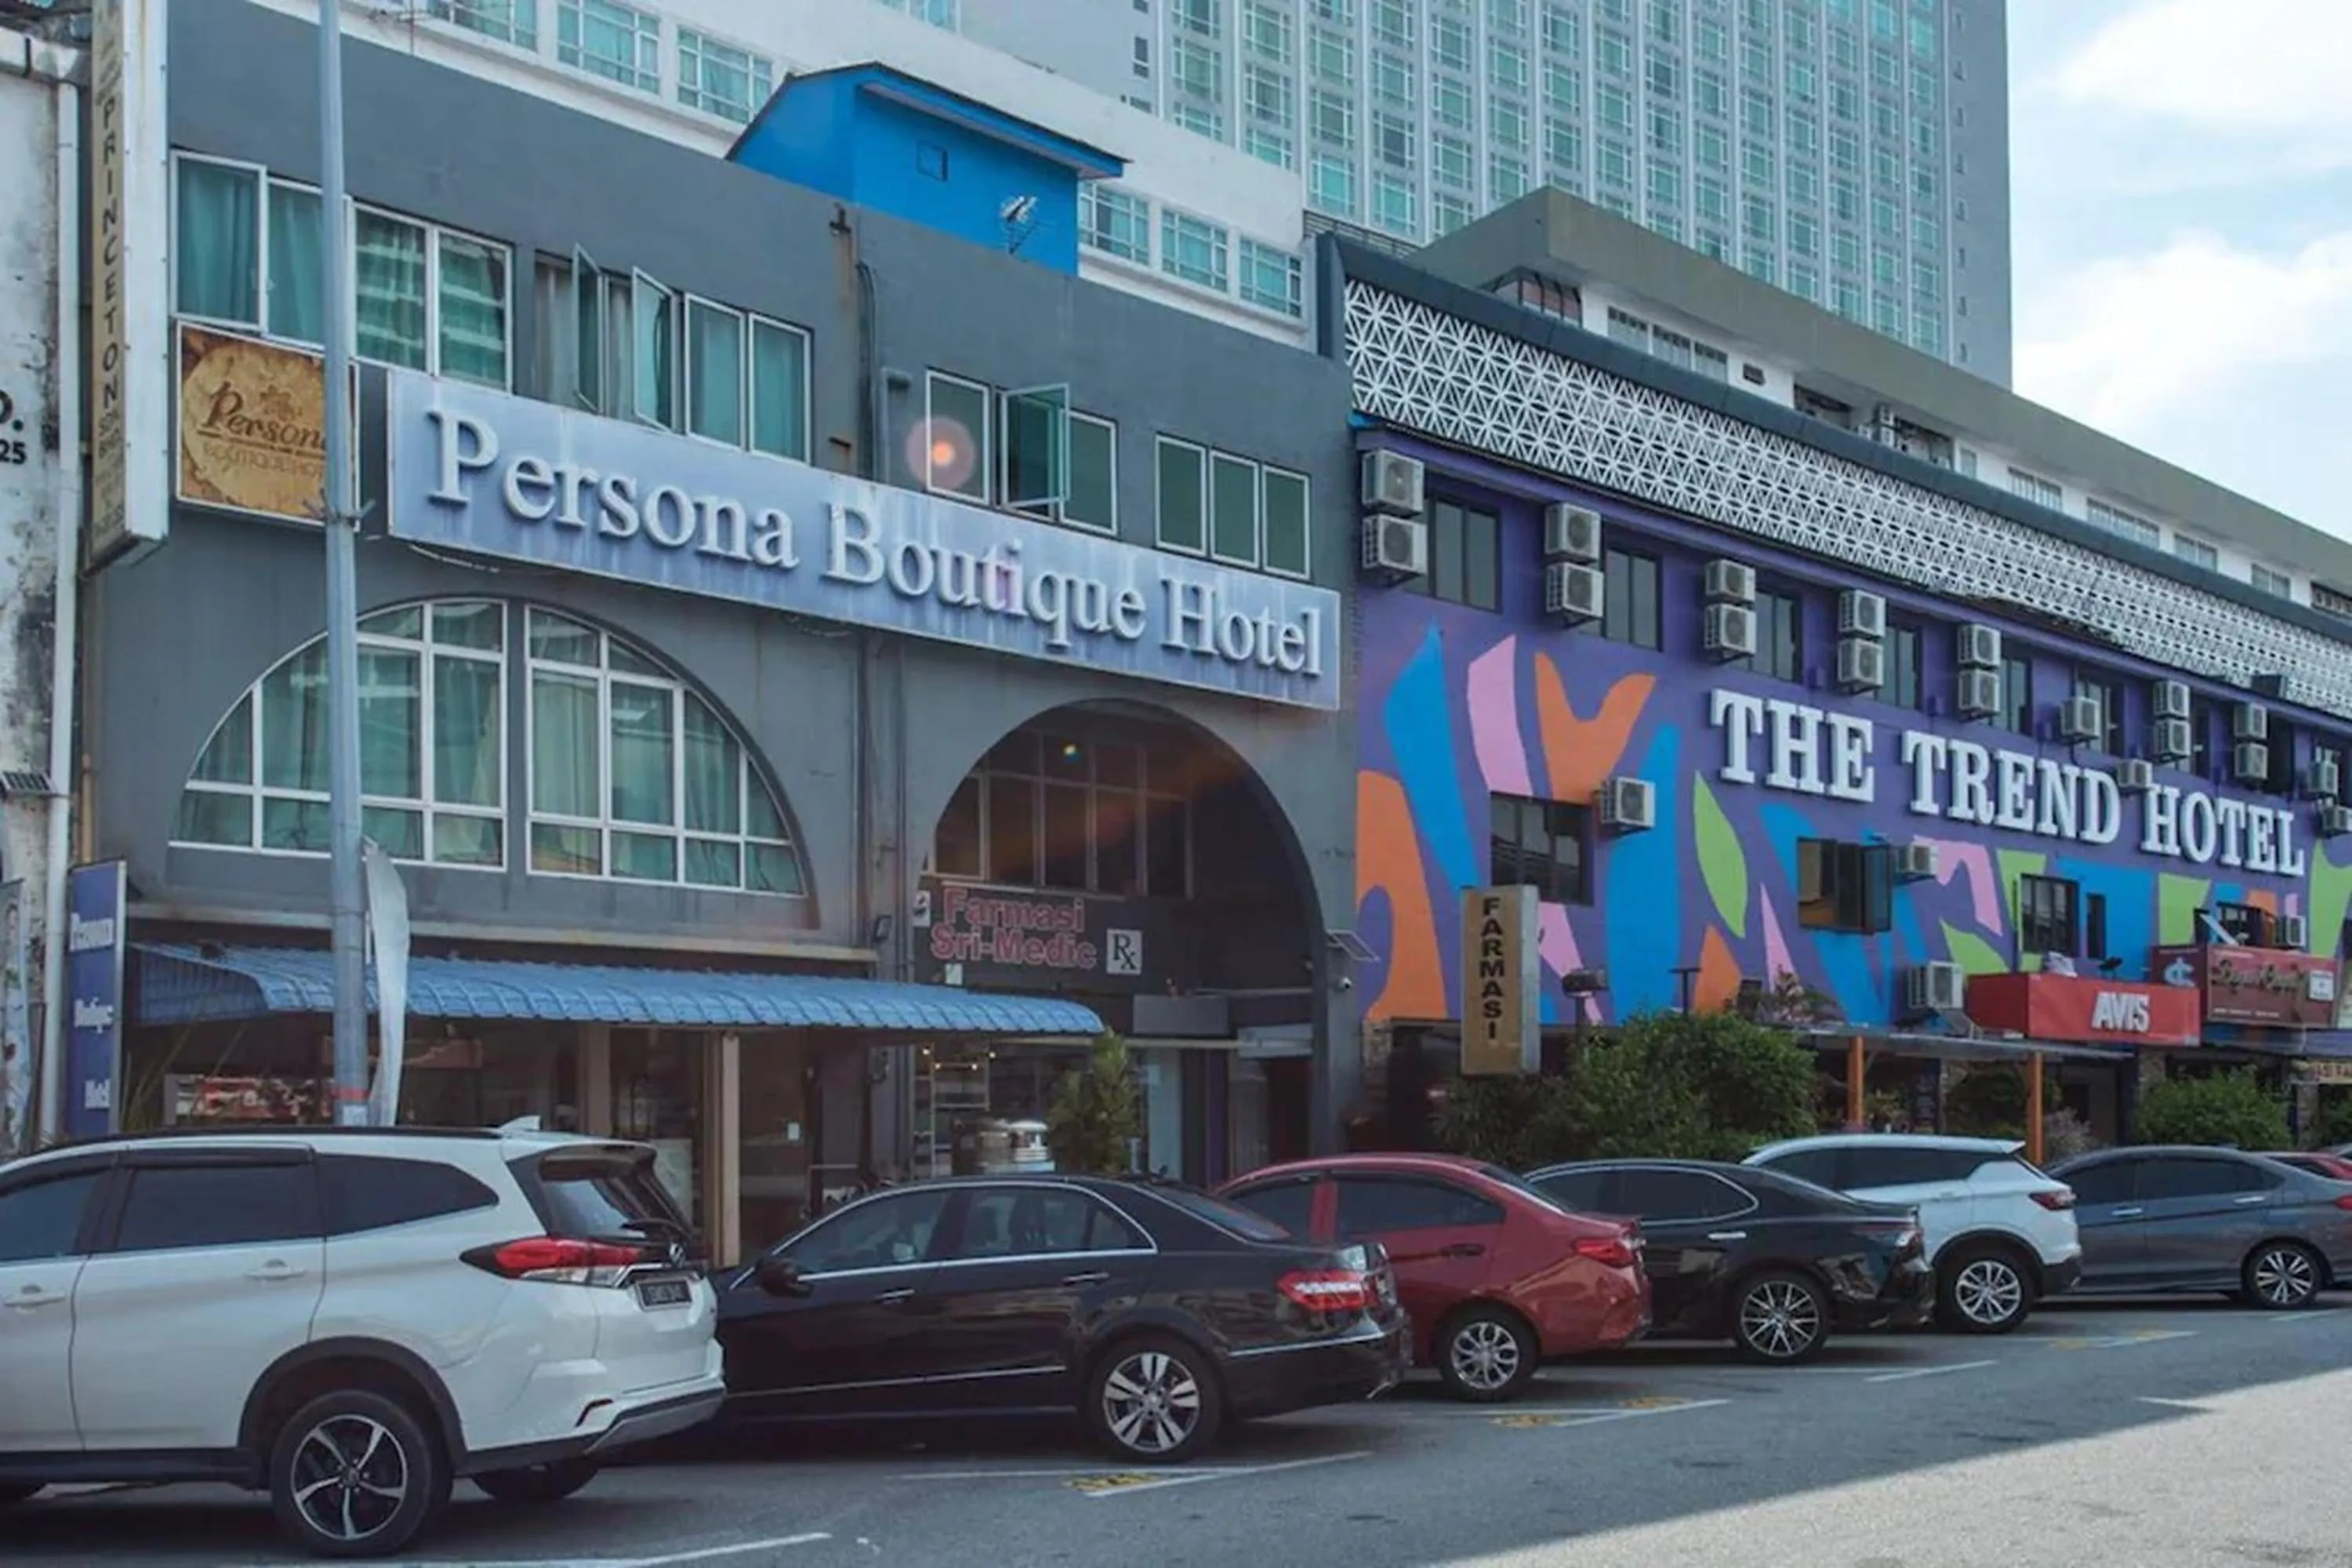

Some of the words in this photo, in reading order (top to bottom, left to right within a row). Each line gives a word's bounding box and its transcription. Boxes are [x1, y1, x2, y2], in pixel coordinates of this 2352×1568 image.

[103, 96, 118, 408] PRINCETON
[201, 381, 326, 450] Person
[427, 407, 800, 571] Persona
[820, 500, 1147, 649] Boutique
[1159, 572, 1323, 676] Hotel
[1710, 688, 1875, 804] THE
[1902, 729, 2122, 844] TREND
[2139, 782, 2305, 877] HOTEL
[931, 923, 1097, 969] Sri-Medic
[943, 887, 1085, 933] Farmasi
[1479, 898, 1504, 1040] FARMASI
[2091, 991, 2150, 1033] AVIS
